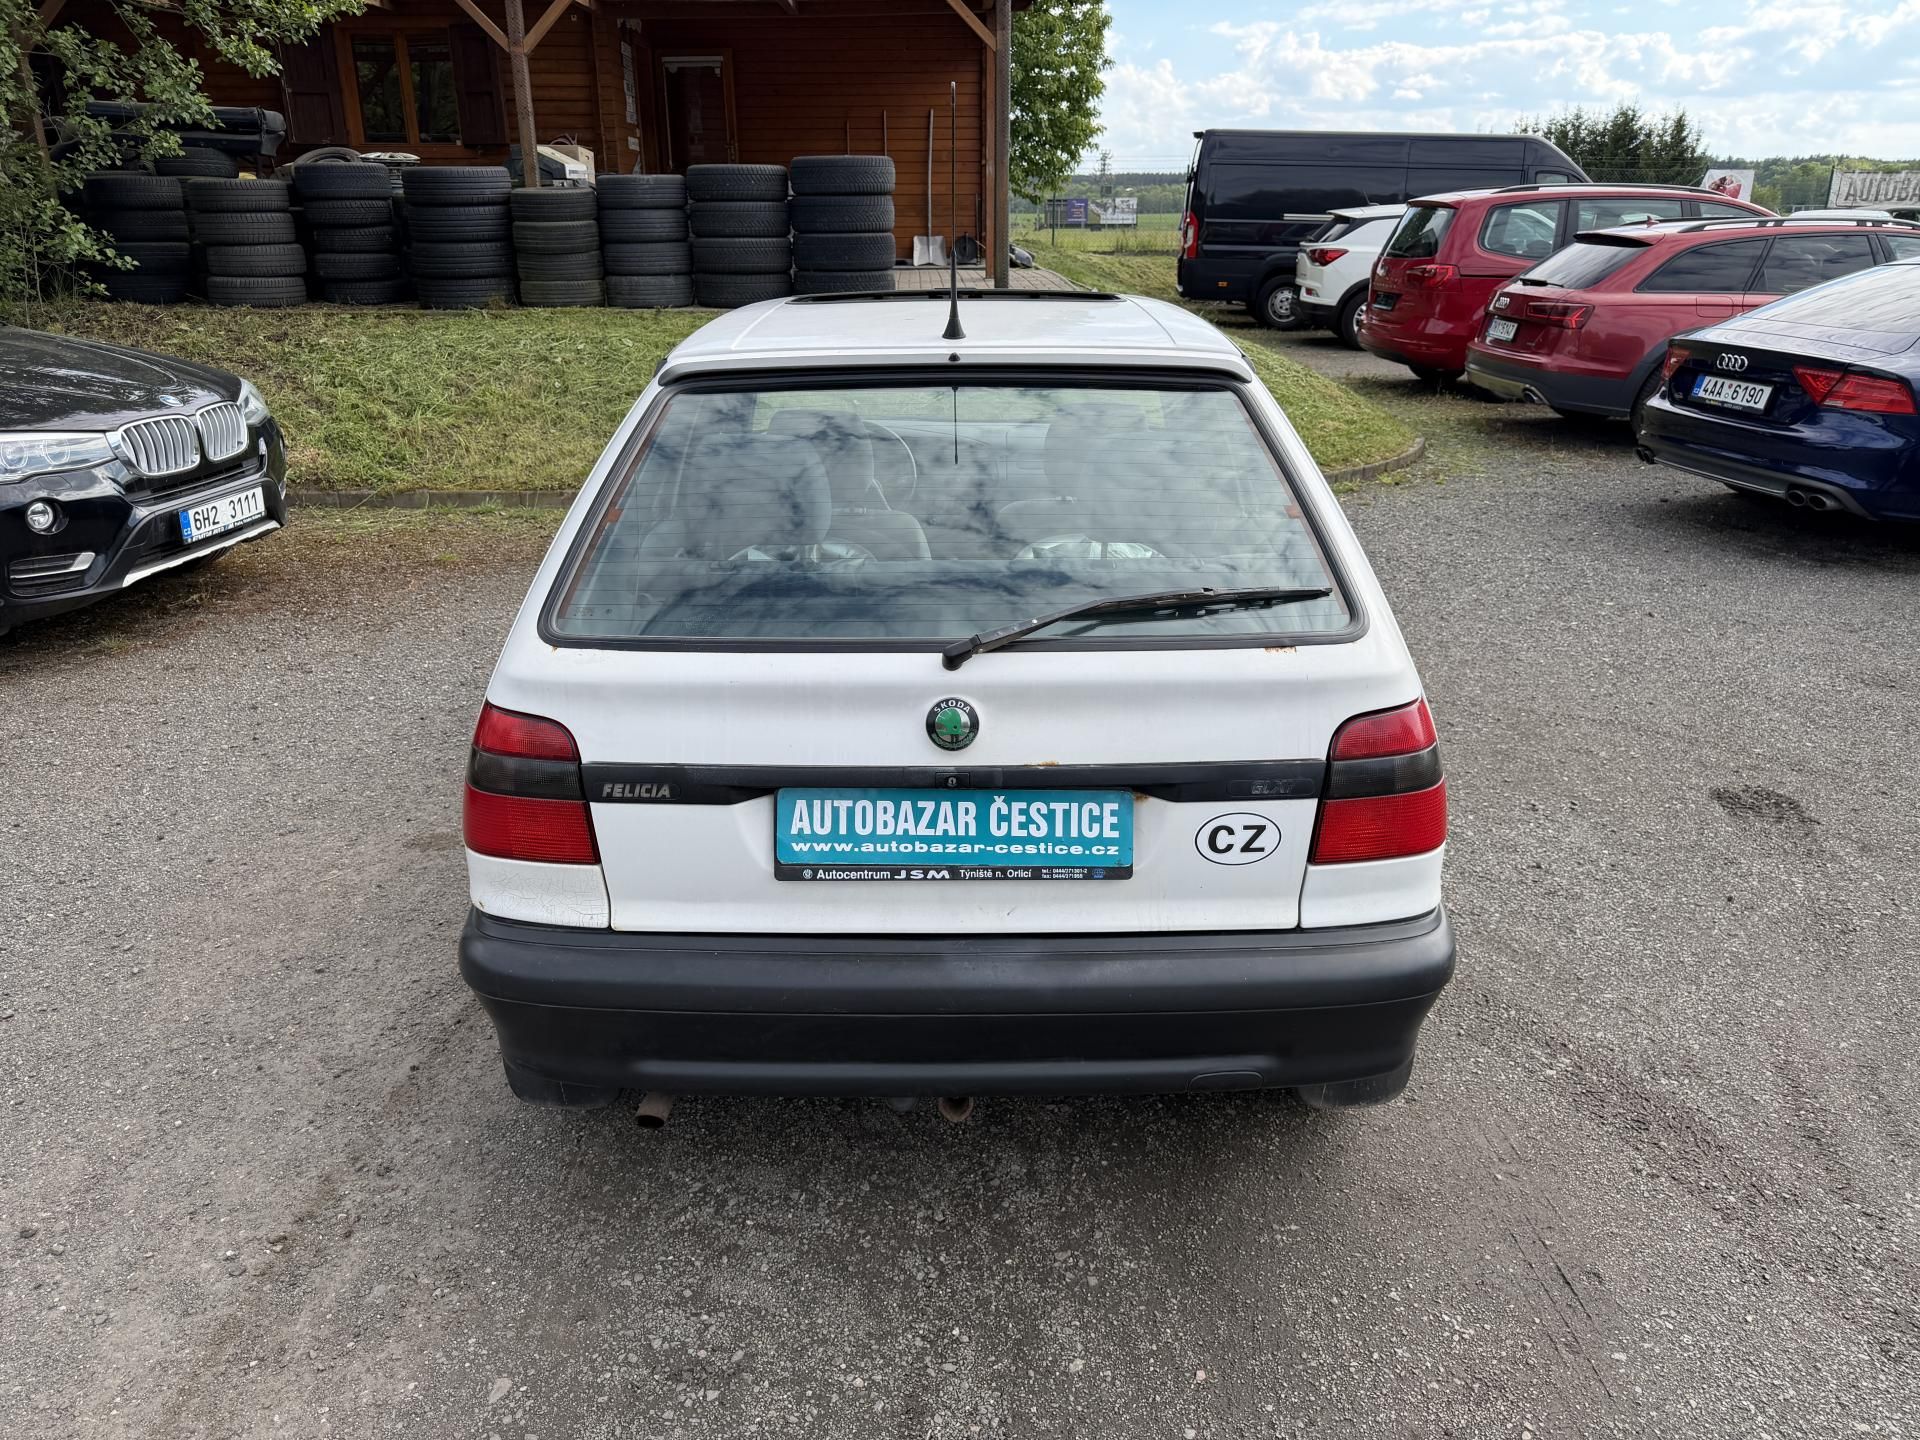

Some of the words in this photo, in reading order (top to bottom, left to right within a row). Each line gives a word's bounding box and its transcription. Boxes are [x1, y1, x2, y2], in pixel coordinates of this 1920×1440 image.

[1702, 379, 1726, 399] 4AA
[1731, 385, 1764, 405] 6190
[193, 506, 220, 531] 6H2
[228, 491, 258, 519] 3111
[602, 783, 671, 798] FELICIA
[790, 799, 977, 836] AUTOBAZAR
[989, 796, 1120, 838] ČESTICE
[791, 841, 1119, 855] www.autobazar-cestice.cz
[1208, 825, 1267, 854] CZ
[816, 869, 890, 880] Autocentrum
[894, 869, 950, 879] JSM
[959, 868, 992, 880] Týniště
[1006, 868, 1032, 878] Orlicí
